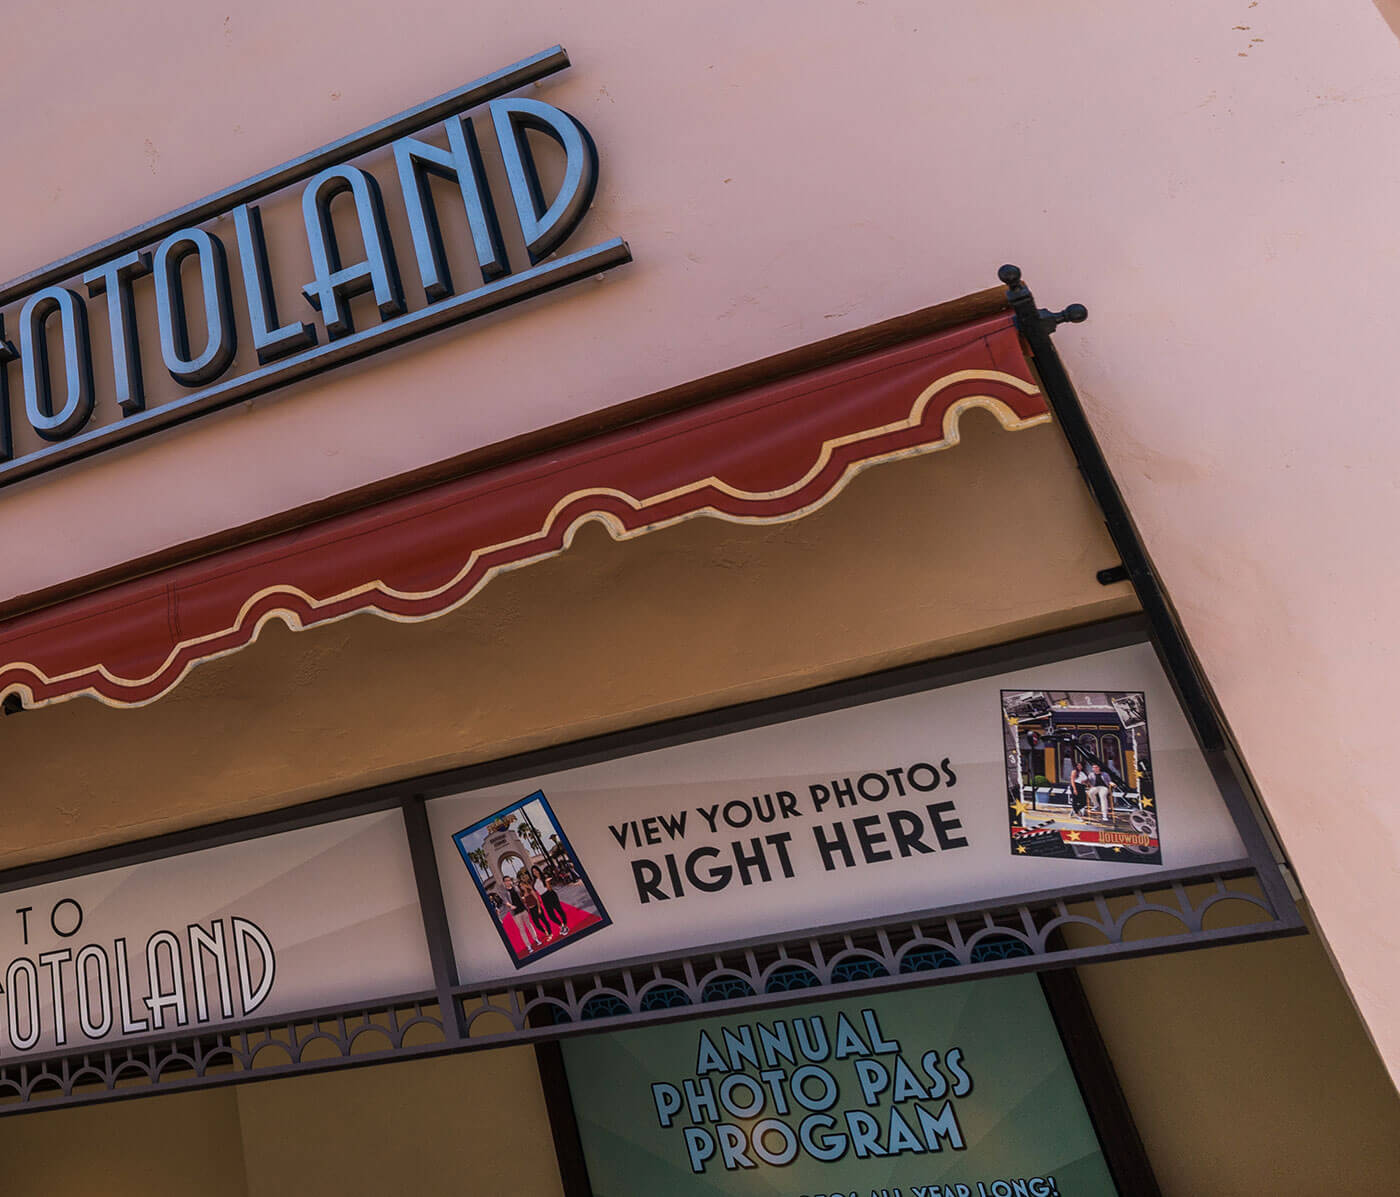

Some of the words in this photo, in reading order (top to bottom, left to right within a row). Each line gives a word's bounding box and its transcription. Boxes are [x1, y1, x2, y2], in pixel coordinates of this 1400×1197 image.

[608, 810, 688, 850] VIEW
[696, 790, 803, 833] YOUR
[808, 757, 958, 813] PHOTOS
[630, 831, 795, 905] RIGHT
[812, 800, 969, 871] HERE
[15, 897, 84, 945] TO
[696, 1008, 901, 1076] ANNUAL
[650, 1063, 838, 1128] PHOTO
[854, 1047, 974, 1107] PASS
[683, 1099, 967, 1174] PROGRAM
